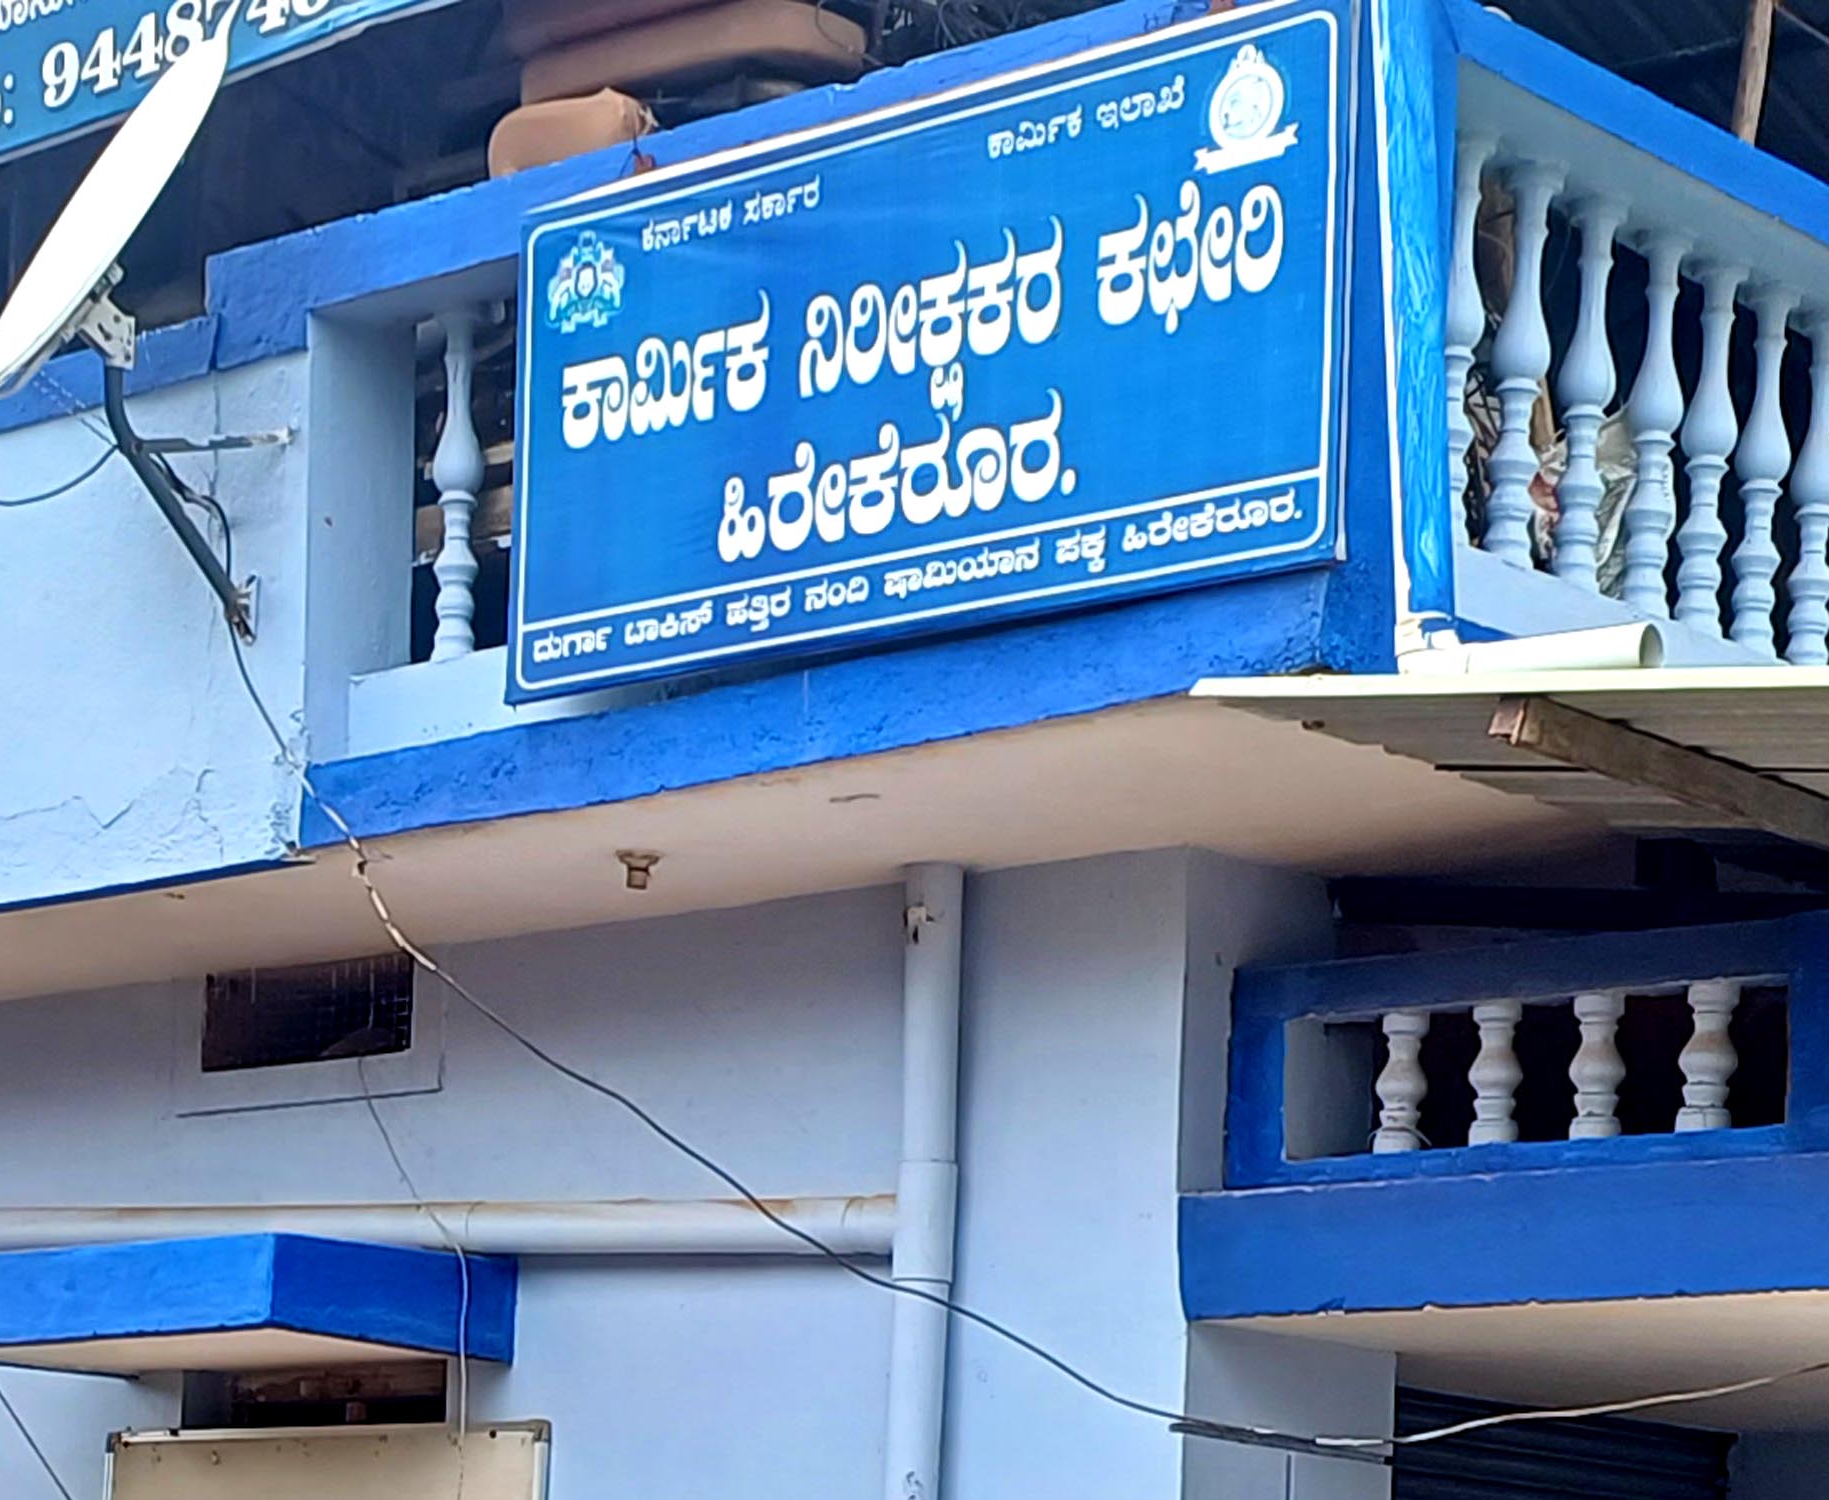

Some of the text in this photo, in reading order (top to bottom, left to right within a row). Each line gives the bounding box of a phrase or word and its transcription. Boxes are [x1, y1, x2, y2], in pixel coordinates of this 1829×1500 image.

[986, 74, 1186, 160] ಕಾರ್ಮಿಕ ಇಲಾಖೆ
[641, 174, 821, 252] ಕರ್ನಾಟಕ ಸರ್ಕಾರ
[559, 180, 1285, 450] ಕಾರ್ಮಿಕ ನಿರೀಕ್ಷಕರ ಕಛೇರಿ
[715, 387, 1078, 564] ಹಿರೇಕೆರೂರ.
[532, 625, 613, 664] ದುರ್ಗಾ
[726, 585, 792, 633] ಹತ್ತಿರ
[804, 575, 871, 613] ನಂದಿ
[1054, 524, 1109, 574] ಪಕ್ಕ
[1121, 486, 1303, 553] ಹಿರೇಕೆರೂರ.
